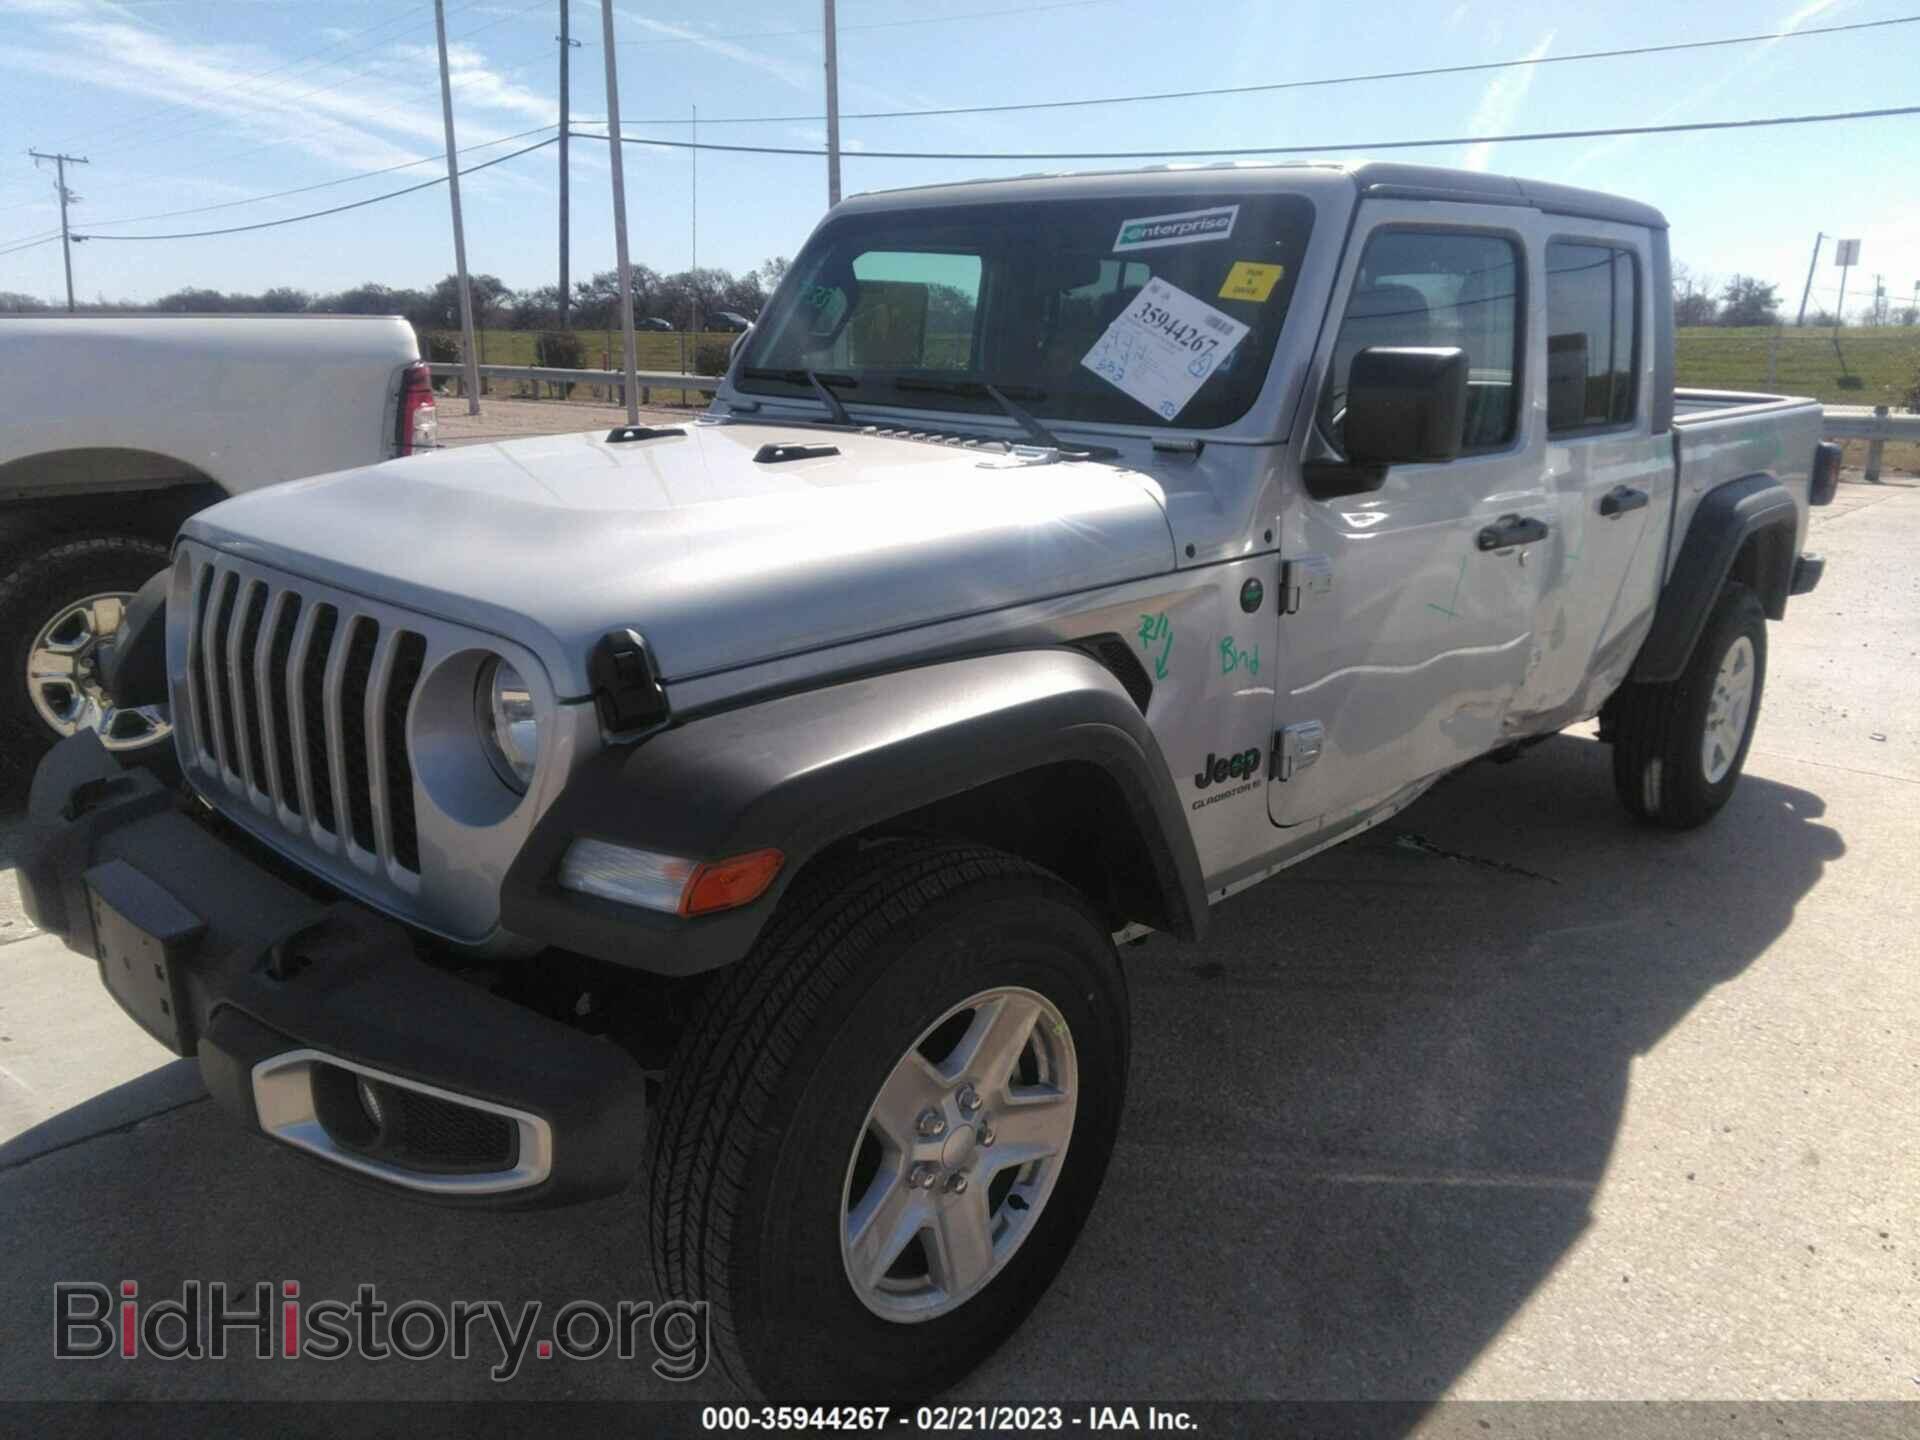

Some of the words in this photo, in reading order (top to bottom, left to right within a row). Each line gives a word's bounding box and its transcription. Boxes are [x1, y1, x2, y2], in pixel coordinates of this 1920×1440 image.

[1126, 215, 1230, 240] enterprise
[1133, 302, 1219, 357] 35944267
[1195, 748, 1260, 788] Jeep
